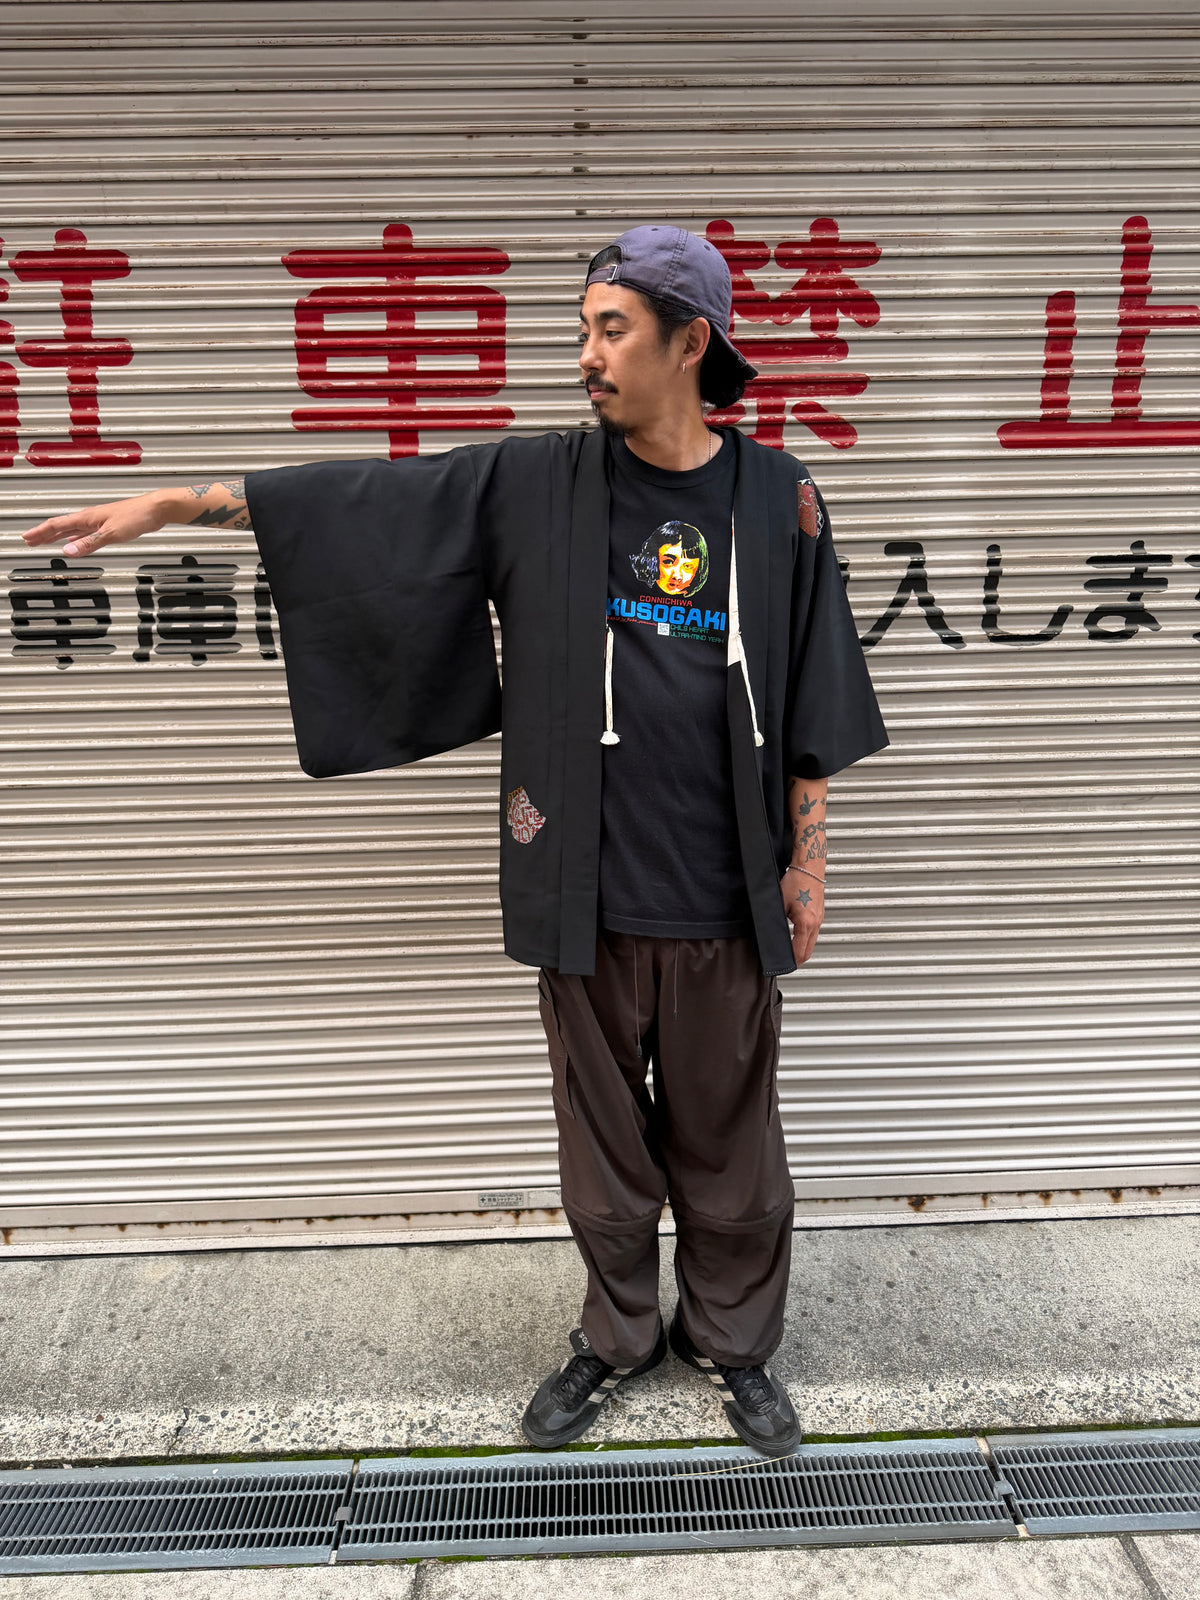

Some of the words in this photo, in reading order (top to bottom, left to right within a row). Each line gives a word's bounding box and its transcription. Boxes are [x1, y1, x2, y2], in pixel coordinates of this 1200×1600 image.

[639, 595, 693, 606] CONNICHIWA
[606, 597, 726, 631] KUSOGAKI
[688, 626, 710, 634] HEART
